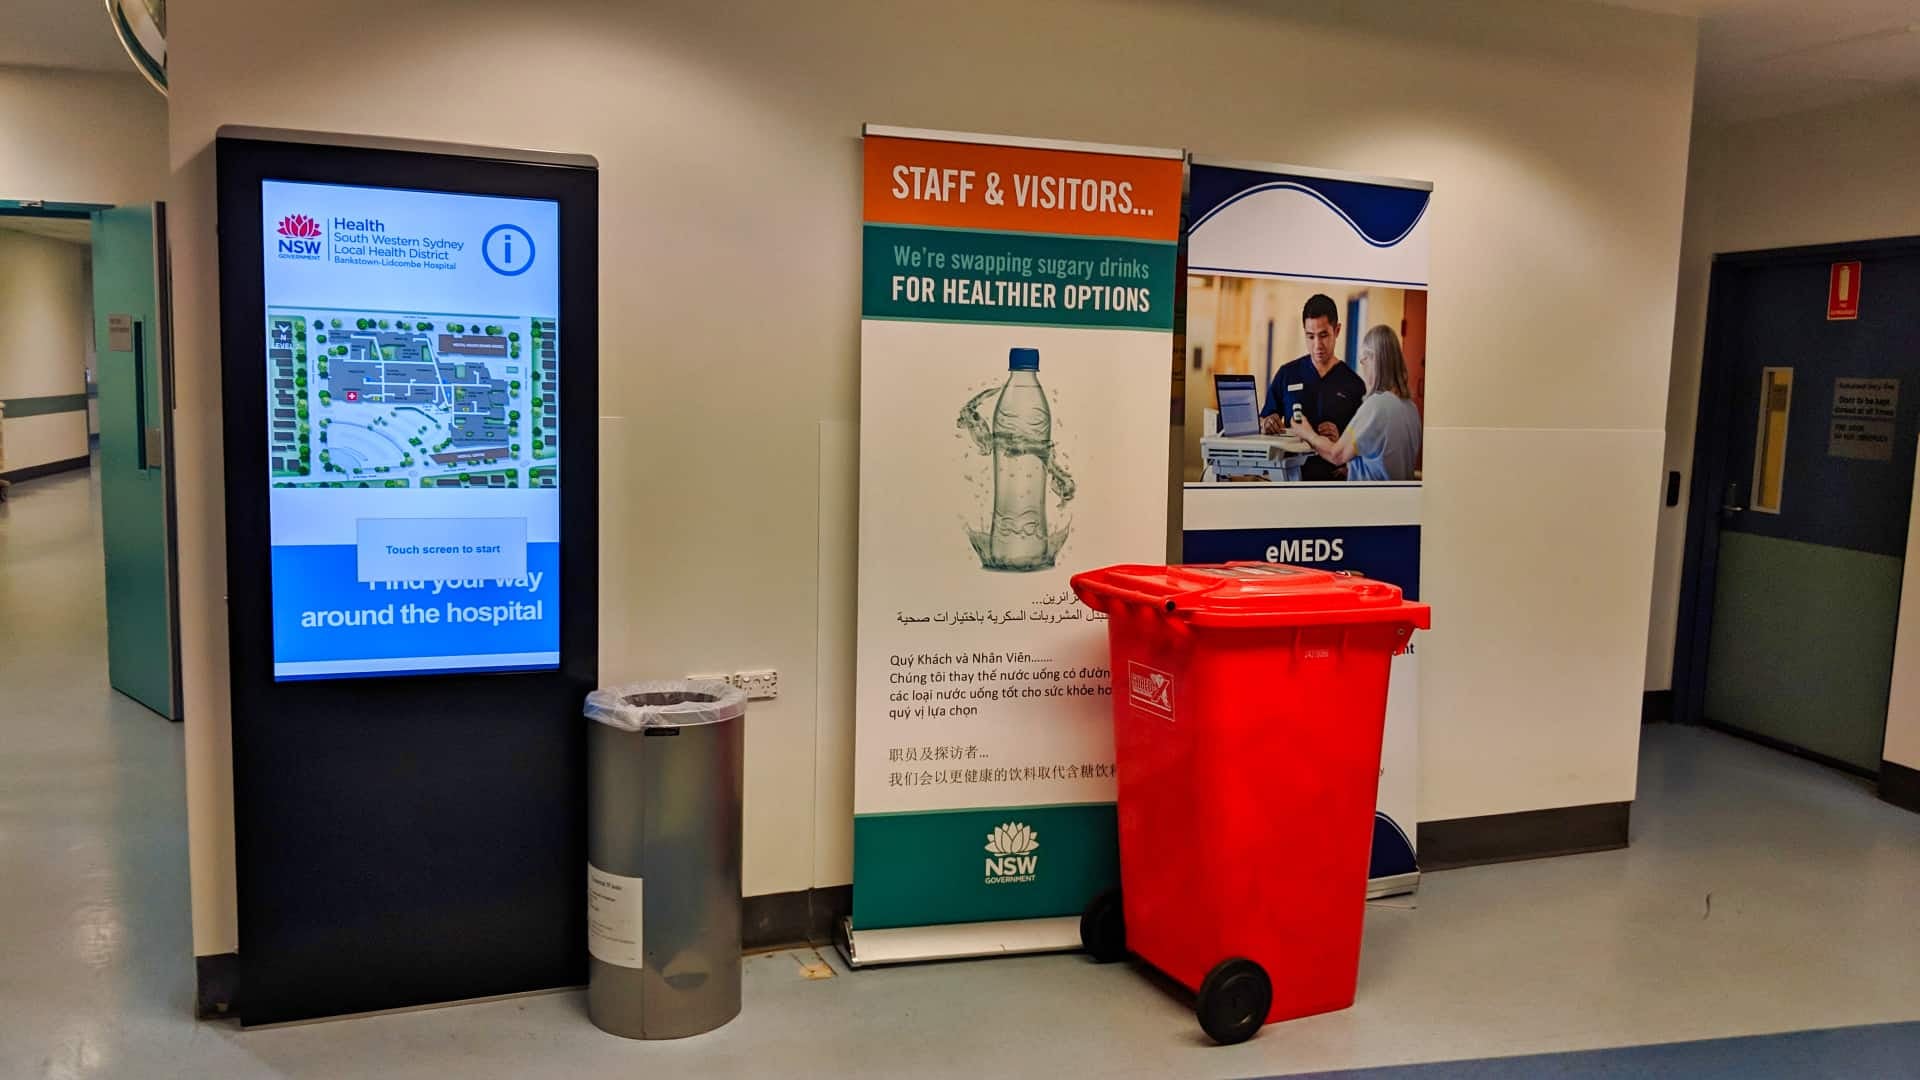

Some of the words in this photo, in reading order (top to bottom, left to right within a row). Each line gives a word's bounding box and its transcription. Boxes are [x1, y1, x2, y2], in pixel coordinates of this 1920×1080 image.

[892, 165, 976, 204] STAFF
[985, 172, 1004, 206] &
[1013, 174, 1153, 216] VISITORS...
[334, 217, 385, 233] Health
[279, 240, 321, 255] NSW
[334, 233, 369, 244] South
[371, 235, 420, 246] Western
[422, 238, 464, 251] Sydney
[334, 244, 365, 256] Local
[368, 246, 406, 258] Health
[409, 248, 449, 261] District
[334, 257, 421, 269] Bankstown-Lidcombe
[424, 261, 456, 271] Hospital
[894, 245, 945, 269] We're
[951, 251, 1032, 276] swapping
[1038, 257, 1094, 280] sugary
[1100, 257, 1150, 280] drinks
[892, 276, 935, 303] FOR
[943, 278, 1056, 309] HEALTHIER
[1064, 284, 1150, 312] OPTIONS
[386, 545, 419, 555] Touch
[423, 546, 459, 555] screen
[462, 545, 473, 554] to
[475, 545, 501, 554] start
[1266, 538, 1344, 563] eMEDS
[432, 579, 487, 594] your
[496, 571, 543, 592] way
[301, 604, 394, 628] around
[400, 603, 440, 625] the
[447, 600, 543, 626] hospital
[890, 653, 914, 668] Quý
[917, 652, 953, 665] Khách
[889, 671, 927, 686] Chúng
[930, 670, 946, 683] tôi
[949, 670, 974, 684] thay
[977, 668, 997, 682] thế
[1000, 668, 1029, 681] nước
[1032, 667, 1060, 682] uống
[1079, 667, 1110, 679] đườn
[889, 689, 909, 702] các
[912, 688, 932, 703] loại
[936, 687, 966, 701] nước
[969, 687, 998, 701] uống
[1001, 686, 1019, 699] tốt
[1021, 686, 1042, 698] cho
[1044, 686, 1063, 698] sức
[889, 705, 911, 721] quý
[914, 706, 924, 719] vị
[928, 705, 946, 718] lựa
[949, 704, 978, 718] chọn
[985, 855, 1037, 876] NSW
[985, 875, 1035, 884] GOVERNMENT
